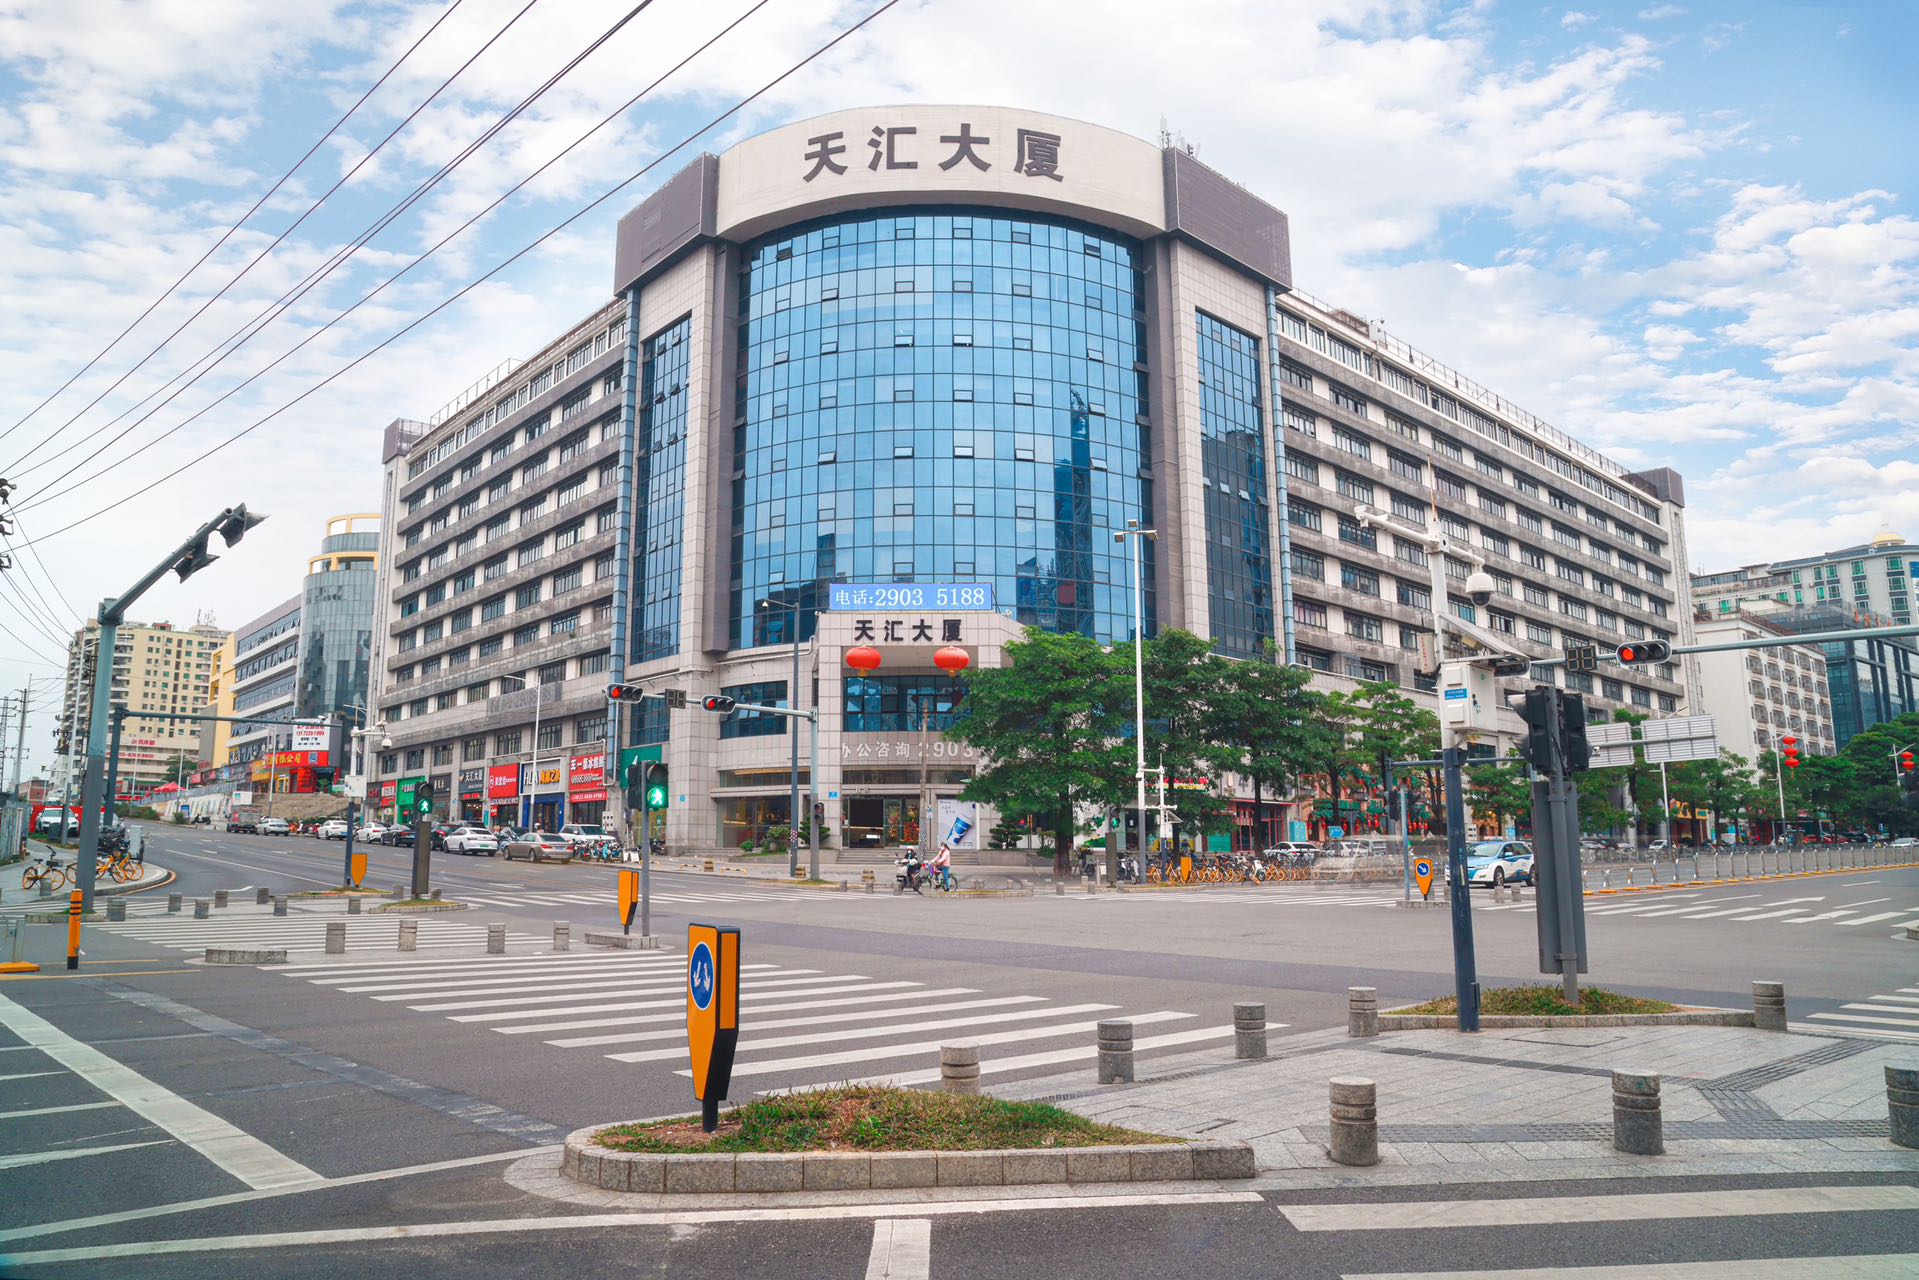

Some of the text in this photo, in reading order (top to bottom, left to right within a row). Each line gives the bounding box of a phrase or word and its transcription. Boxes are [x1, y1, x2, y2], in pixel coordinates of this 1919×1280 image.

[803, 123, 1064, 183] 天汇大厦
[936, 588, 985, 606] 5188
[854, 619, 962, 642] 天汇大厦
